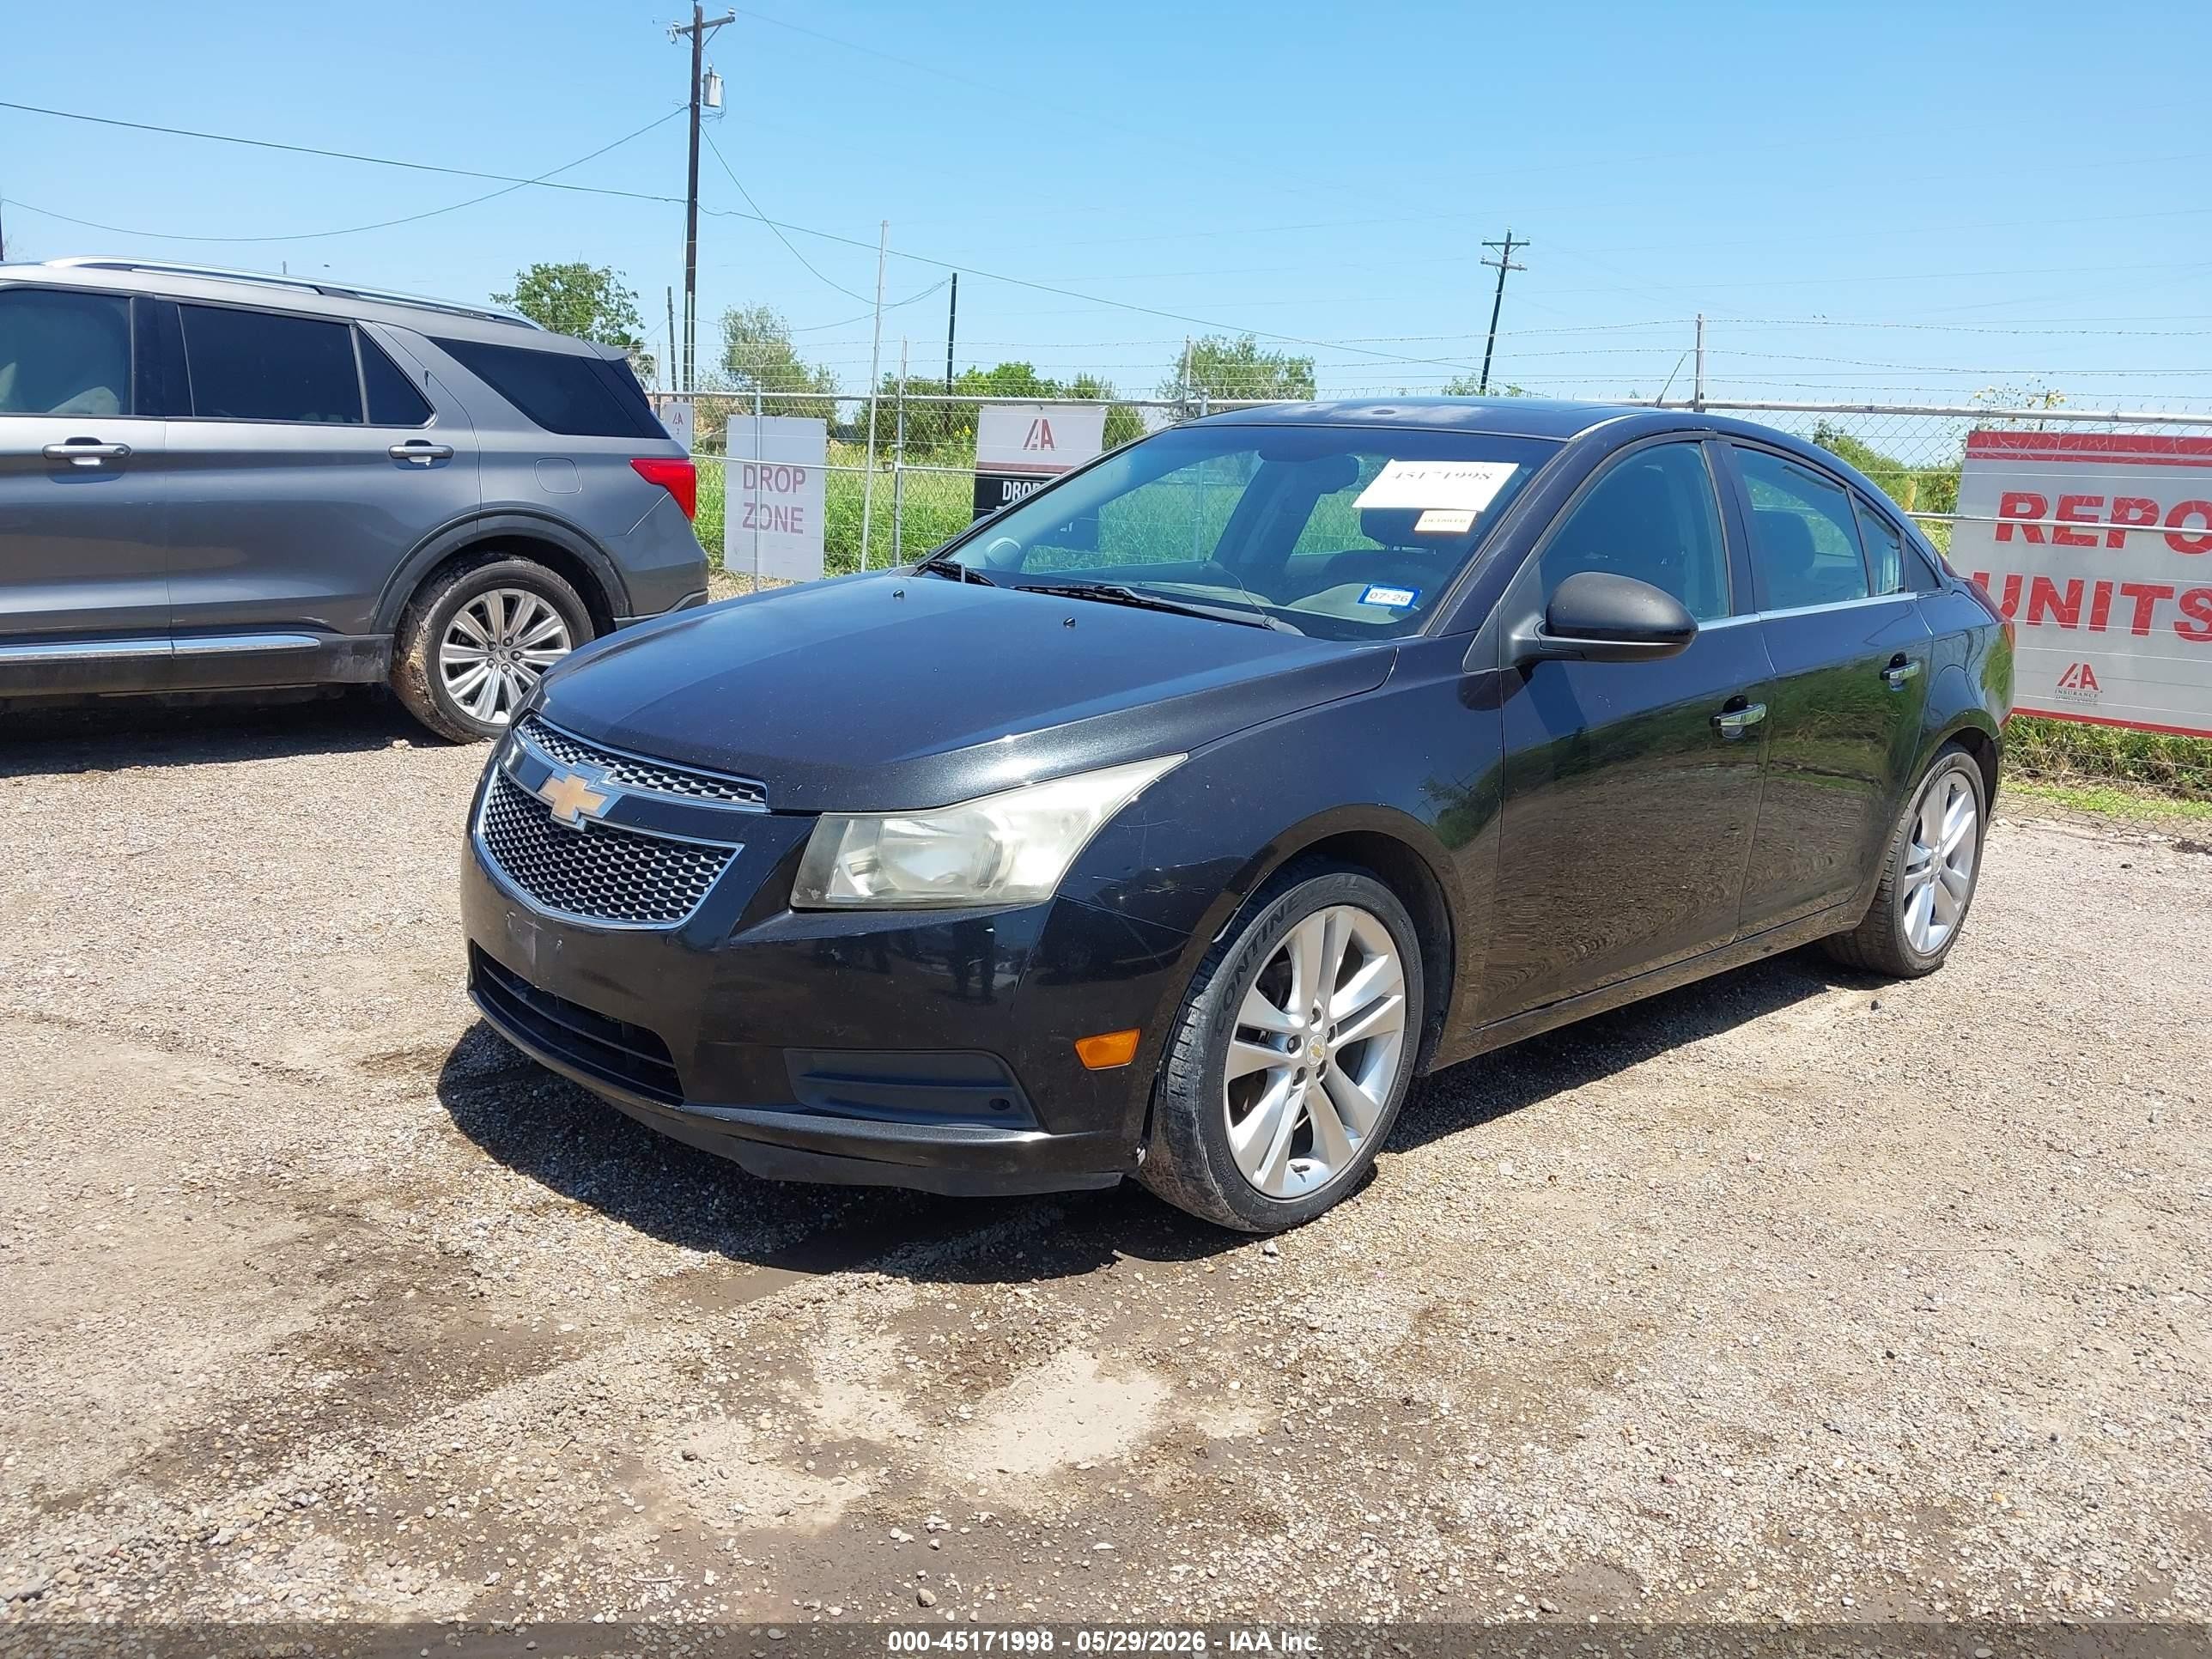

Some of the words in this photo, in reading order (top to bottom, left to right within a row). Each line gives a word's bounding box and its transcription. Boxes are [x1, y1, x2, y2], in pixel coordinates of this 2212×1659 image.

[743, 465, 806, 494] DROP
[742, 501, 804, 534] ZONE
[1995, 492, 2212, 555] REPO
[1972, 571, 2212, 642] UNITS
